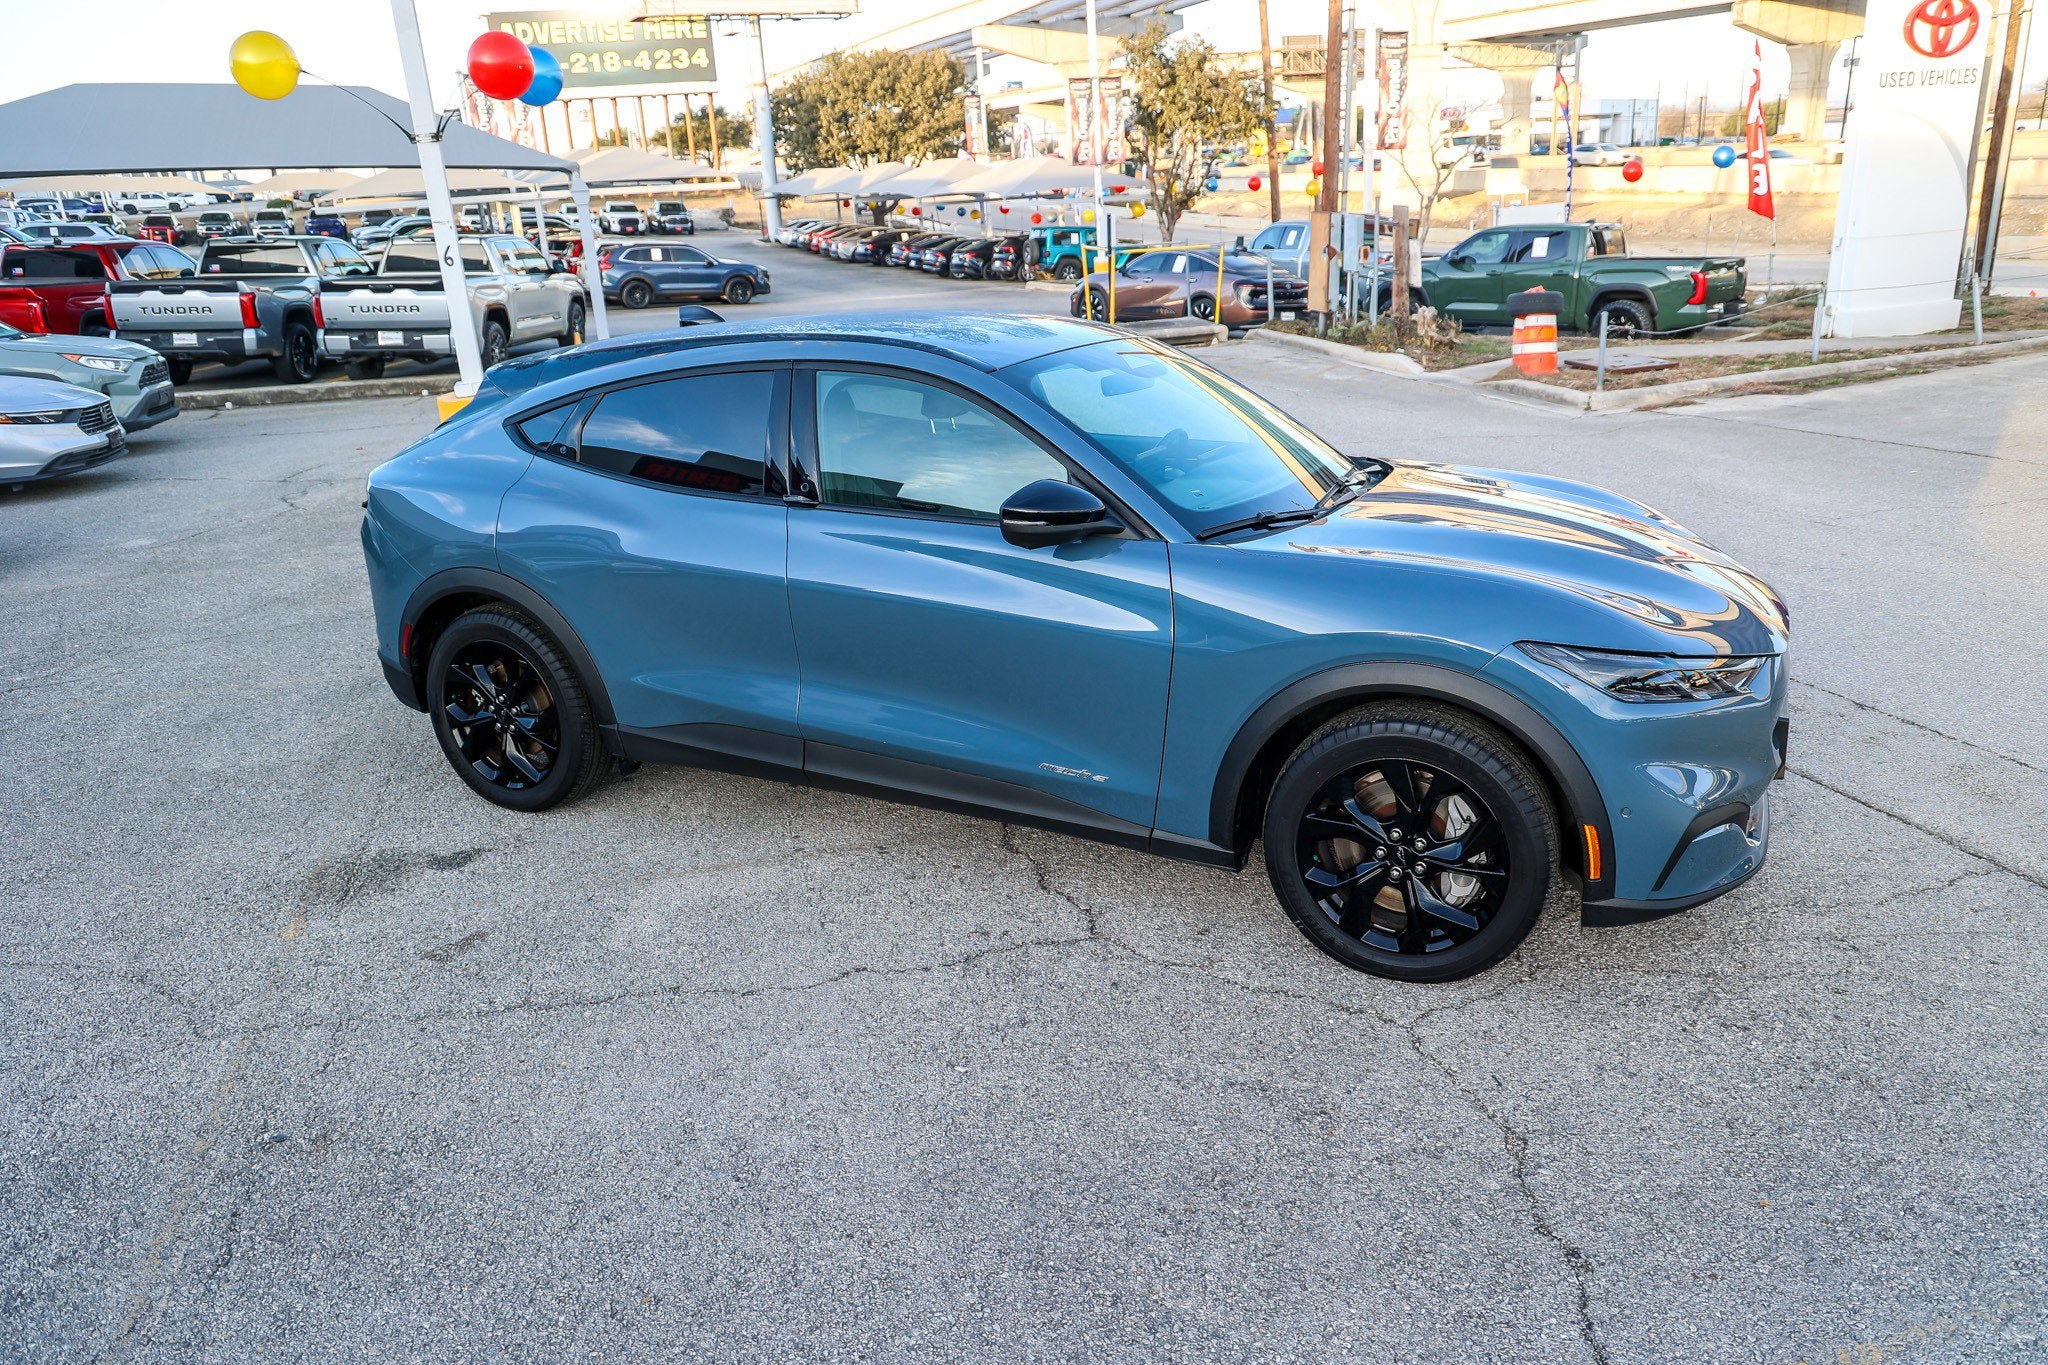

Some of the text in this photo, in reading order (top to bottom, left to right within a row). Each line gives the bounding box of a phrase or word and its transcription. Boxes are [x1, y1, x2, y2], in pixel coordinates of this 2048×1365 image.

[501, 15, 708, 46] ADVERTISE HERE
[561, 47, 710, 74] -218-4234
[1879, 67, 1978, 88] USED VEHICLES
[444, 245, 454, 267] 6
[138, 305, 213, 316] TUNDRA
[347, 303, 421, 315] TUNDRA
